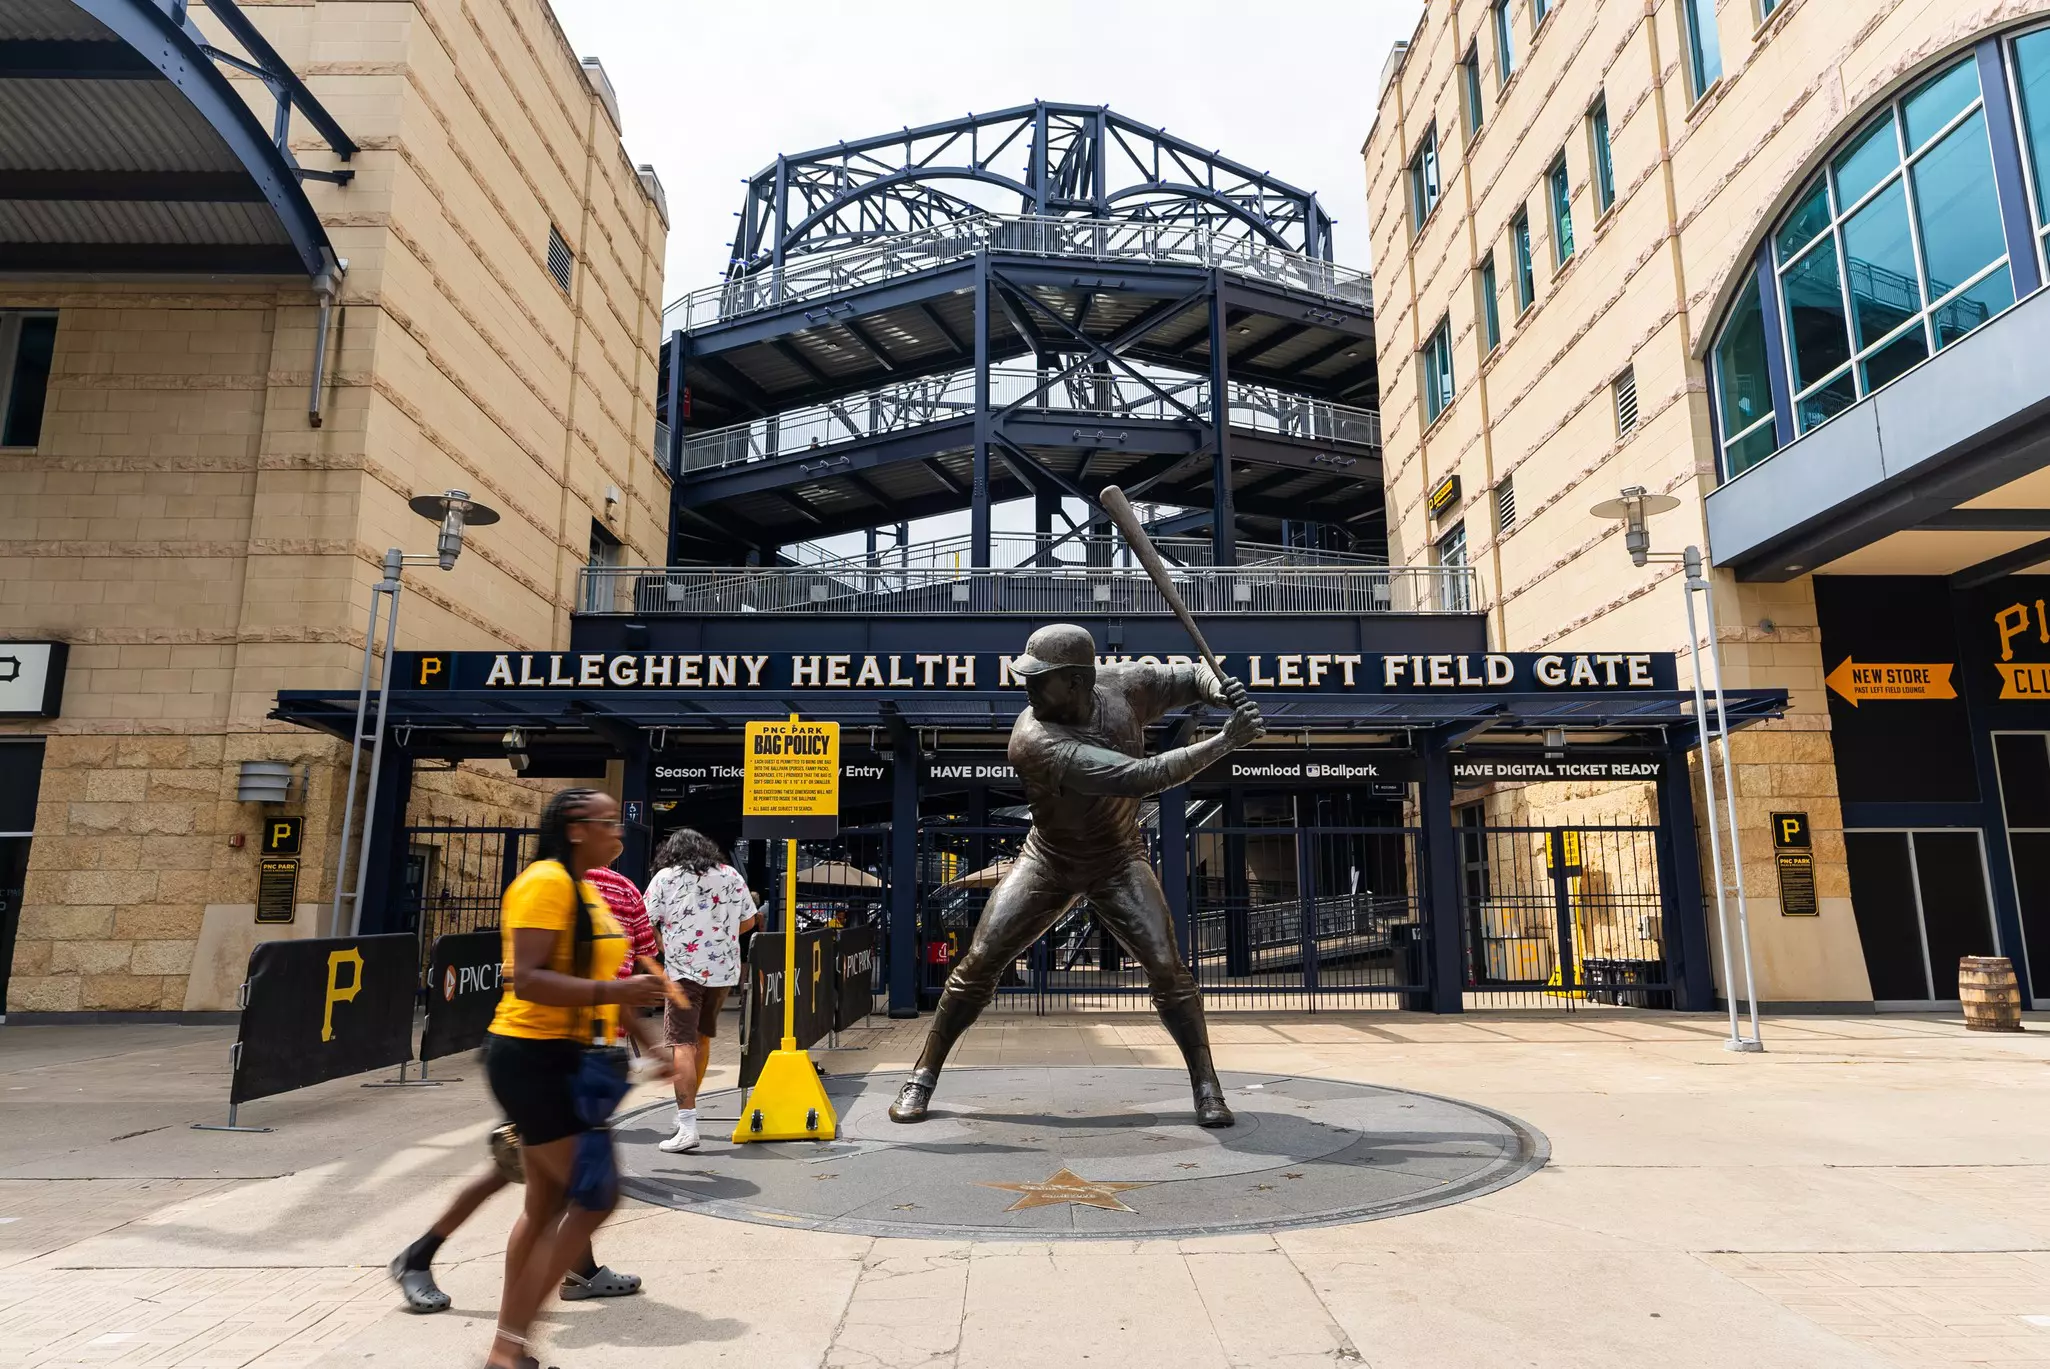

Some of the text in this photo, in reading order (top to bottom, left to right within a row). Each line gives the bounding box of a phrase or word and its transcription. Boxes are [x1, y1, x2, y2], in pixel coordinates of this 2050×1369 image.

[1995, 599, 2050, 661] PI
[420, 657, 442, 685] P
[486, 655, 768, 687] ALLEGHENY
[791, 654, 976, 687] HEALTH
[1248, 654, 1361, 687] LEFT
[1381, 654, 1515, 687] FIELD
[1535, 654, 1654, 687] GATE
[1852, 669, 1930, 684] NEW STORE
[754, 735, 830, 755] BAG POLICY
[655, 766, 706, 778] Season
[710, 766, 744, 778] Ticke
[846, 766, 884, 779] Entry
[930, 766, 1018, 778] HAVE DIGIT
[1232, 764, 1300, 776] Download
[1454, 764, 1660, 776] HAVE DIGITAL TICKET READY
[272, 823, 291, 848] P
[1782, 818, 1800, 842] P
[459, 964, 492, 994] PNC
[765, 971, 782, 1006] PNC
[812, 940, 822, 1014] P
[322, 946, 364, 1042] P
